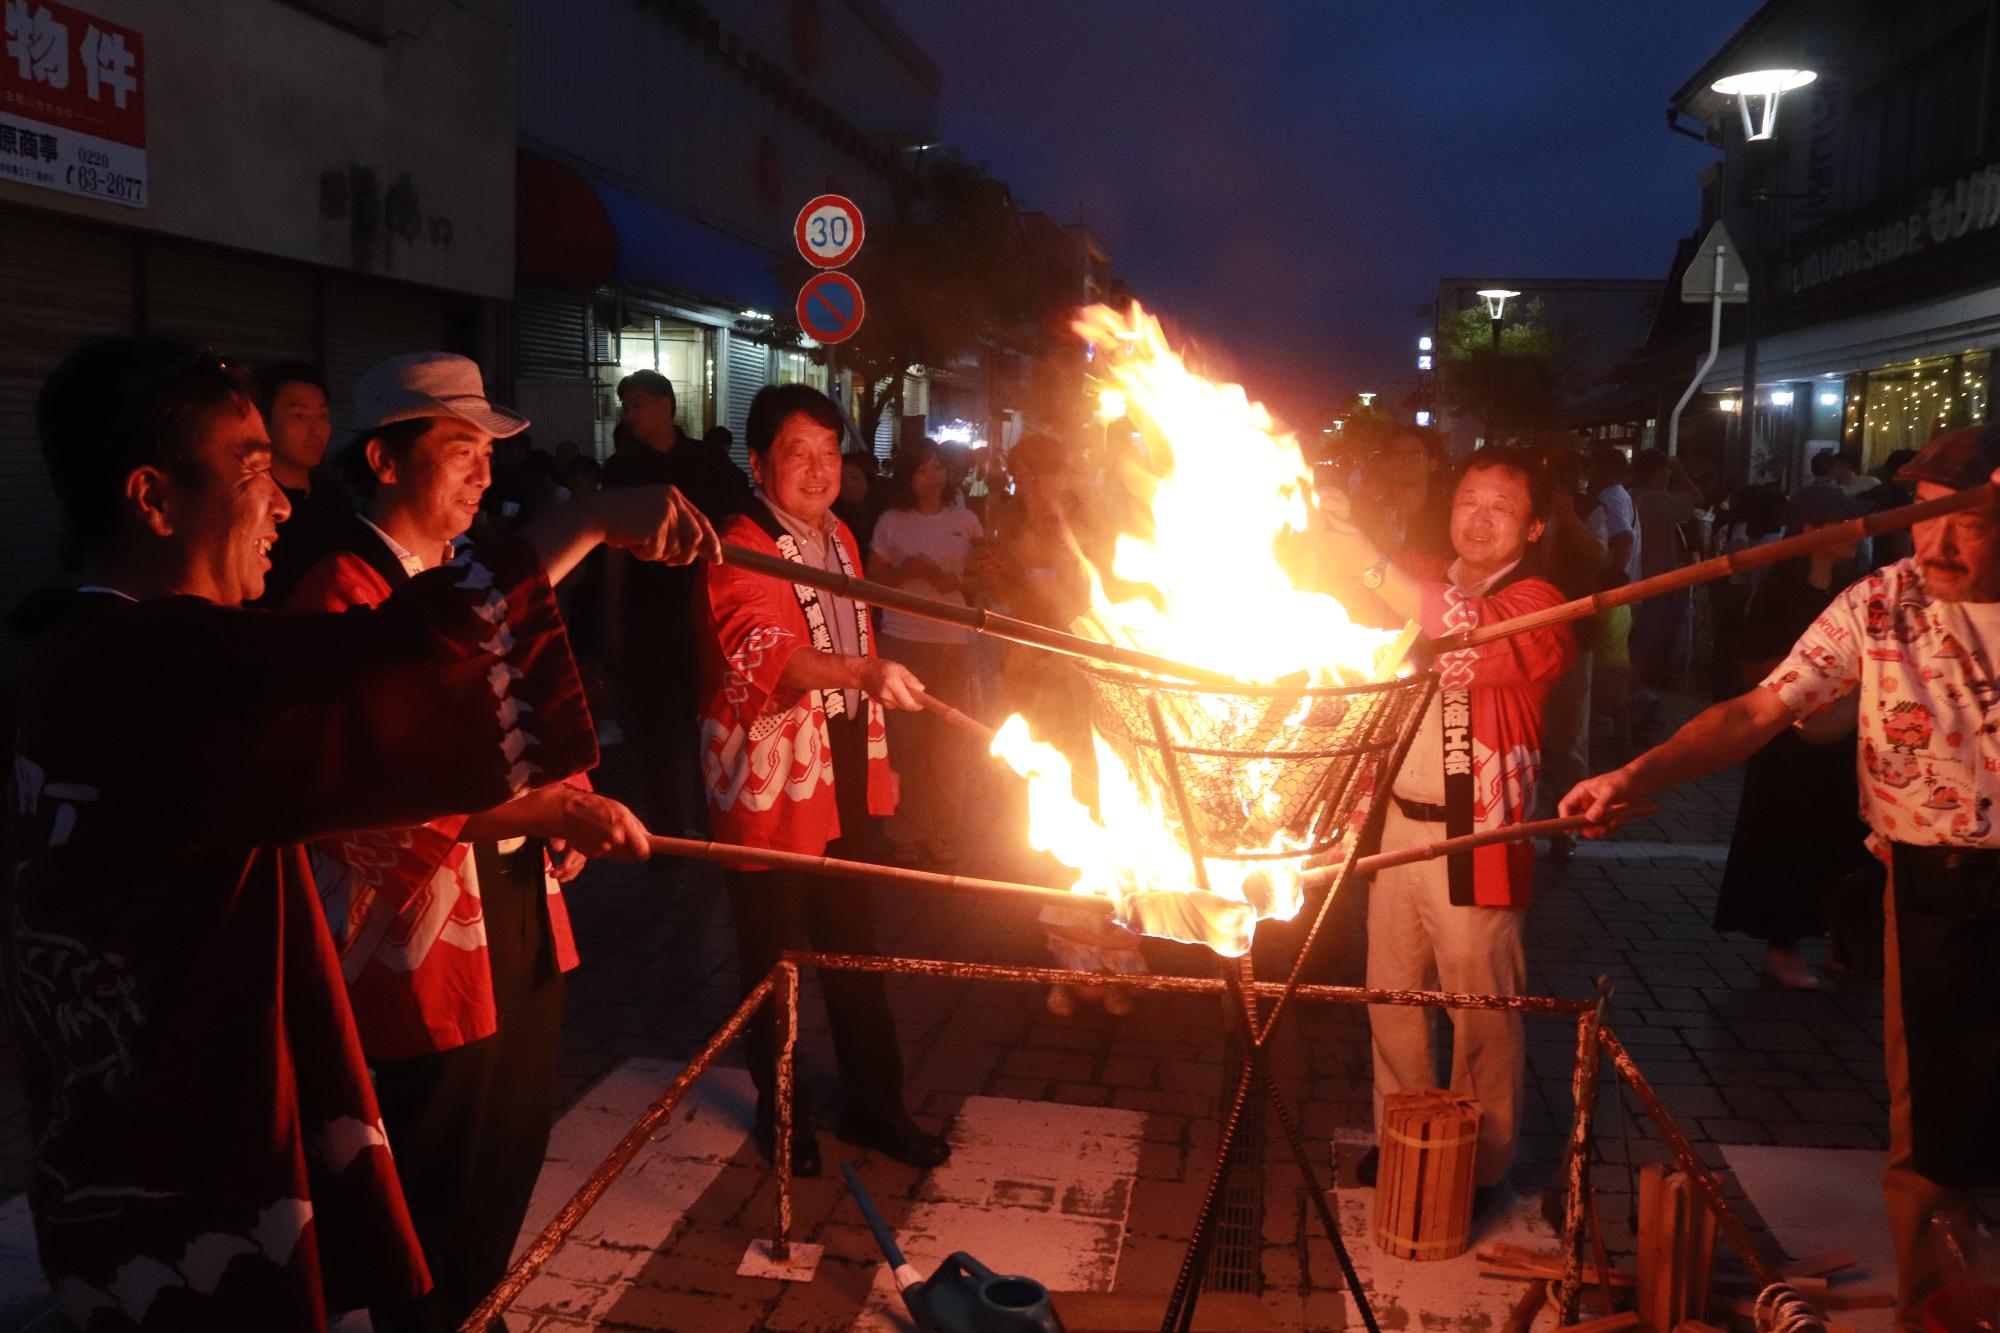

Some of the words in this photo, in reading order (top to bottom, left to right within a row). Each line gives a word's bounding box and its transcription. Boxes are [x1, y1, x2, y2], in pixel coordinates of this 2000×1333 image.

[5, 0, 138, 110] 物件
[78, 148, 109, 168] 0229
[78, 166, 142, 200] 63-2677
[811, 217, 848, 247] 30
[1793, 237, 1859, 294] LIQUOR
[1864, 214, 1922, 271] SHOP
